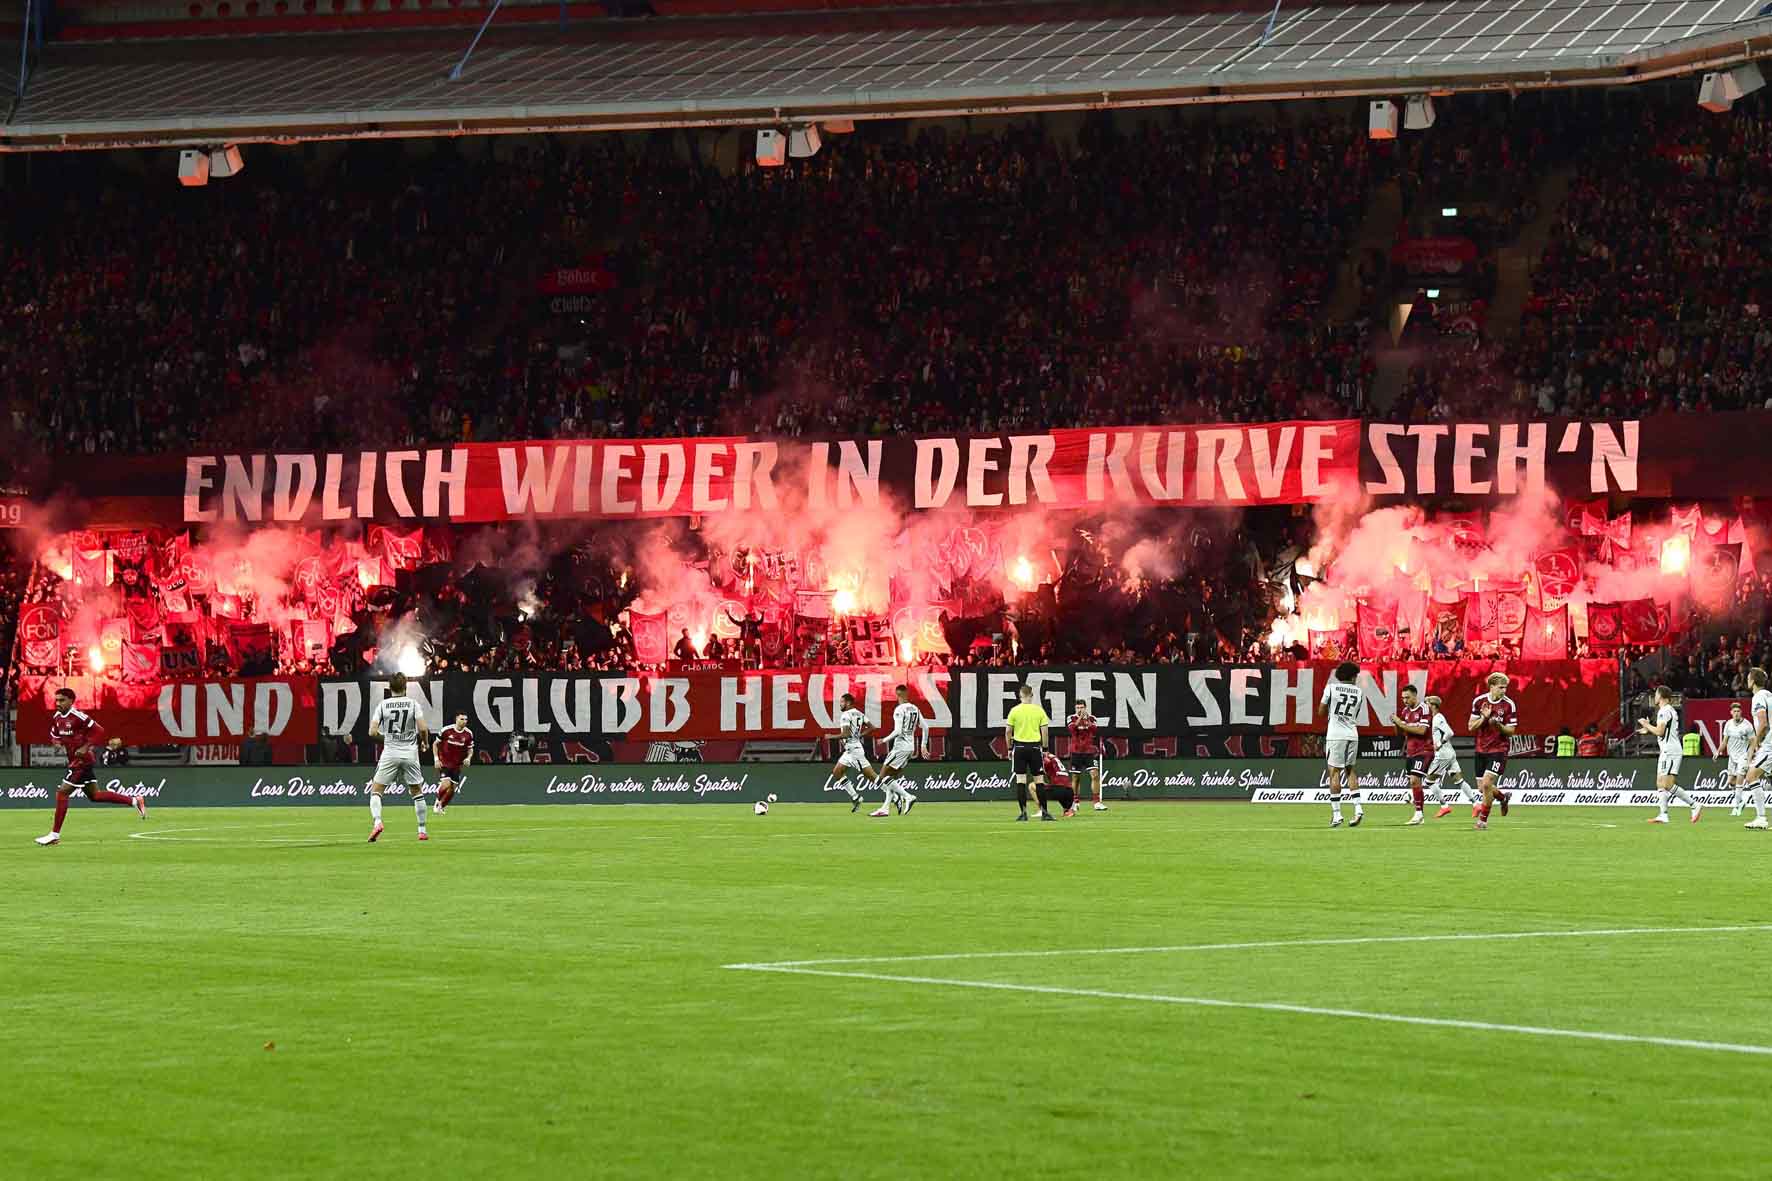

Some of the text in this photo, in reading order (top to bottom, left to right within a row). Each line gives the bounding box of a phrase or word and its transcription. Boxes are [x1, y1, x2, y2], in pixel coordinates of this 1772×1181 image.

[184, 420, 1639, 522] ENDLICH WIEDER IN DER KURVE STEH'N
[158, 682, 293, 738] UND
[473, 677, 691, 733] GLUBB
[720, 672, 893, 731] HEUT
[911, 670, 1157, 729] SIEGEN
[1334, 694, 1358, 717] 22
[388, 710, 409, 734] 21
[1372, 740, 1390, 750] YOU
[1414, 760, 1423, 770] 10
[1492, 761, 1501, 772] 19
[252, 778, 285, 797] Lass
[288, 777, 315, 797] Dir
[319, 778, 357, 796] raten,
[547, 774, 748, 797] Lass Dir raten, trinke Spaten!
[925, 773, 961, 791] trinke
[964, 771, 1016, 795] Spaten!
[1134, 769, 1160, 787] Dir
[1164, 770, 1196, 787] raten,
[1201, 769, 1236, 786] trinke
[1238, 768, 1274, 790] Spaten!
[1496, 769, 1637, 791] Lass Dir raten, trinke Spaten!
[1694, 770, 1717, 789] Lass
[1258, 791, 1304, 801] toolcraft
[1521, 793, 1565, 803] toolcraft
[1575, 793, 1620, 803] toolcraft
